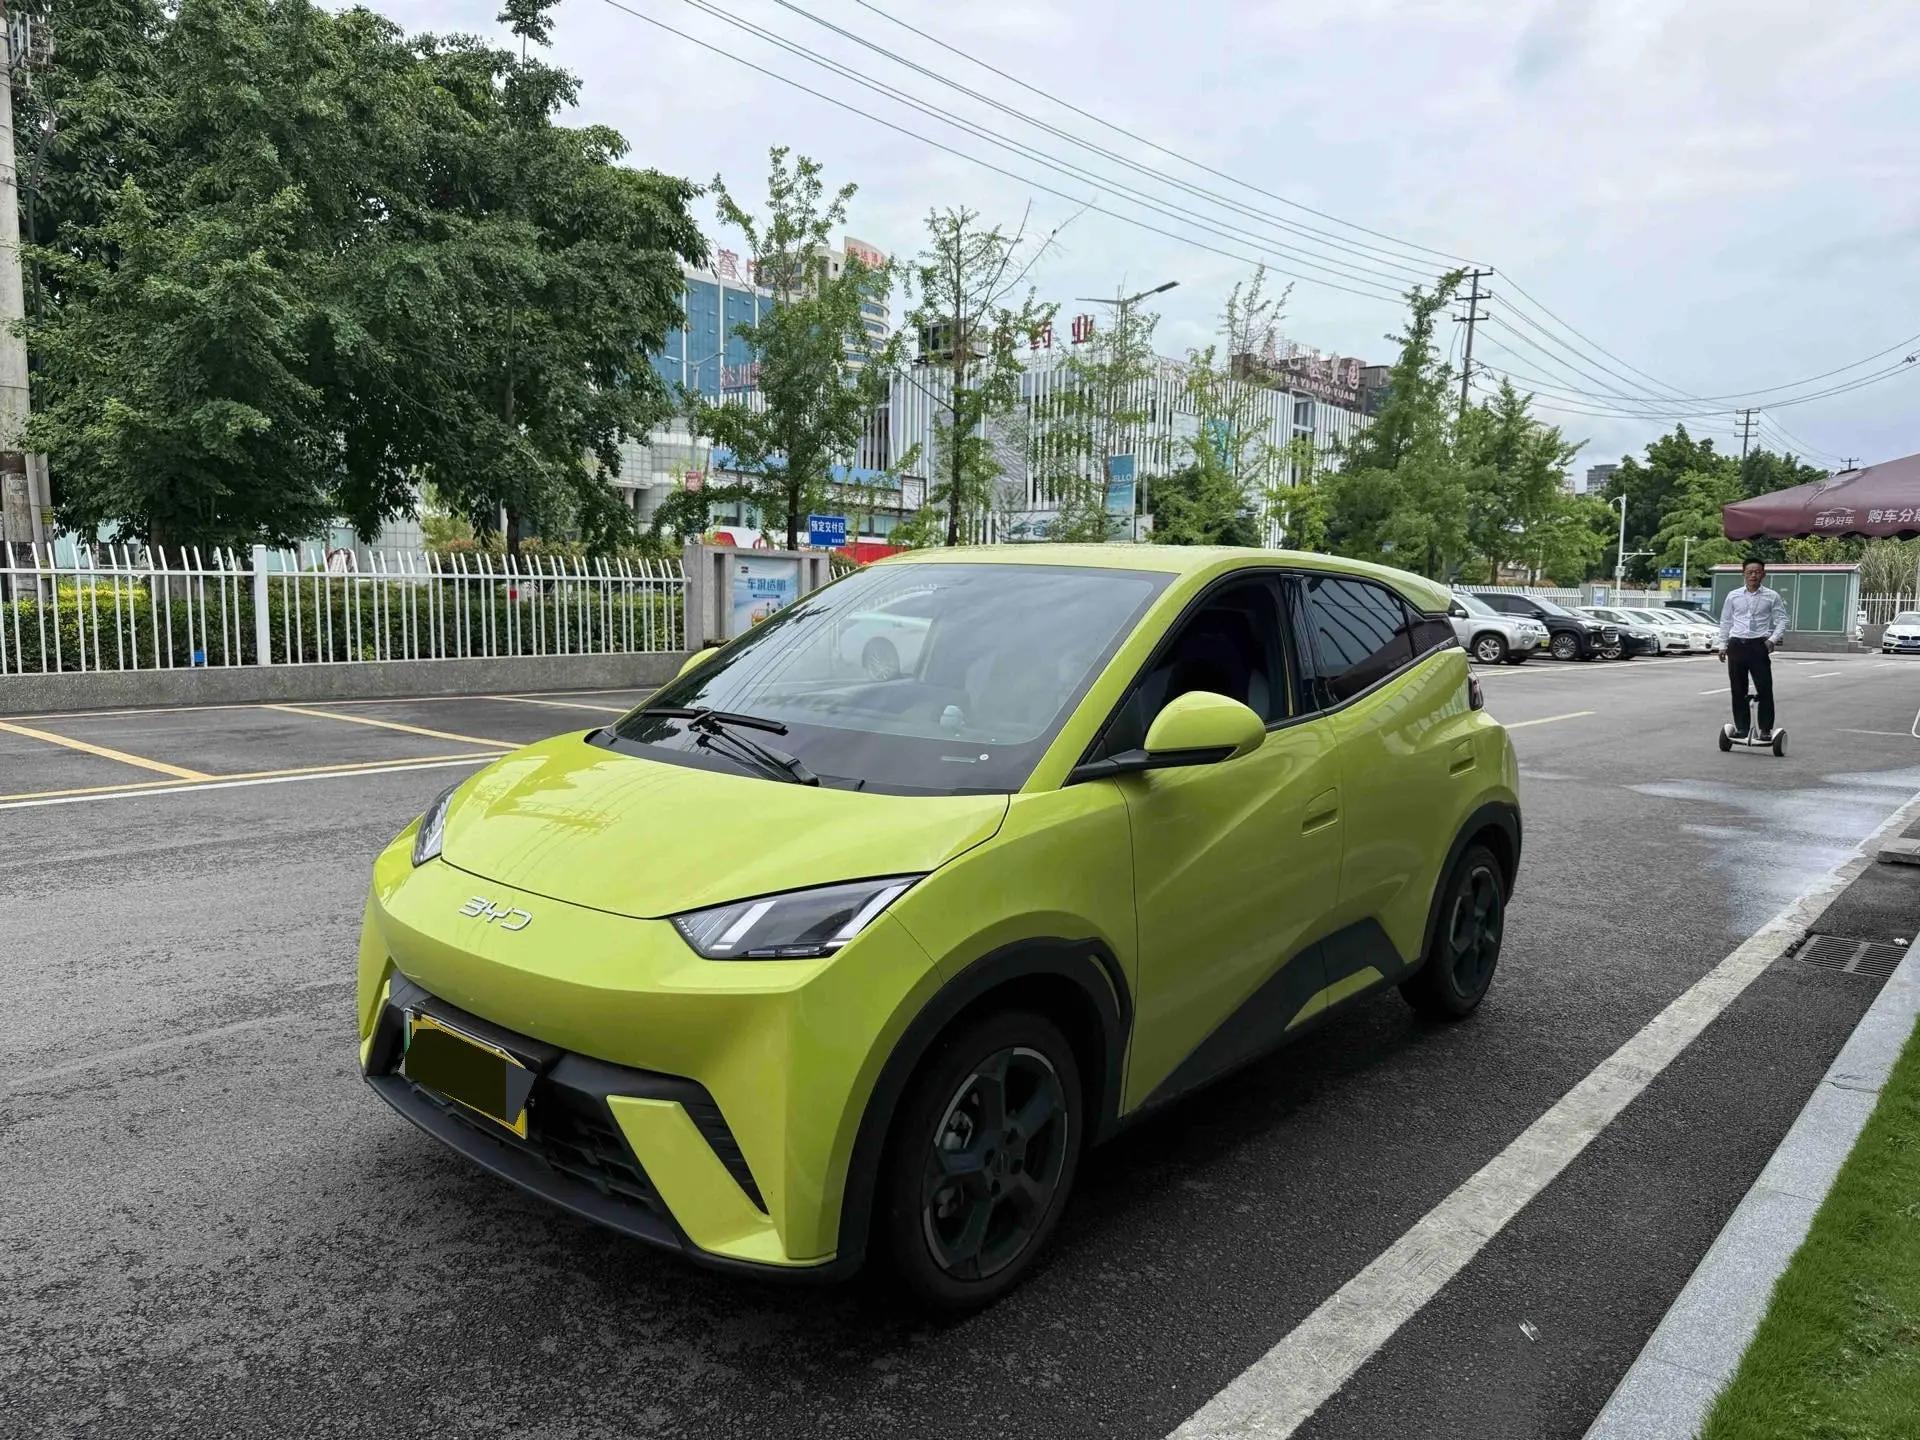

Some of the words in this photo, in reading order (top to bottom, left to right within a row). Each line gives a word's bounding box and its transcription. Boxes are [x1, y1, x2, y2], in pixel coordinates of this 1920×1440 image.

[1285, 374, 1297, 386] BA
[1311, 381, 1330, 395] MAO
[1333, 388, 1356, 402] YUAN
[811, 520, 844, 533] 预定交付区
[458, 895, 533, 932] BYD
